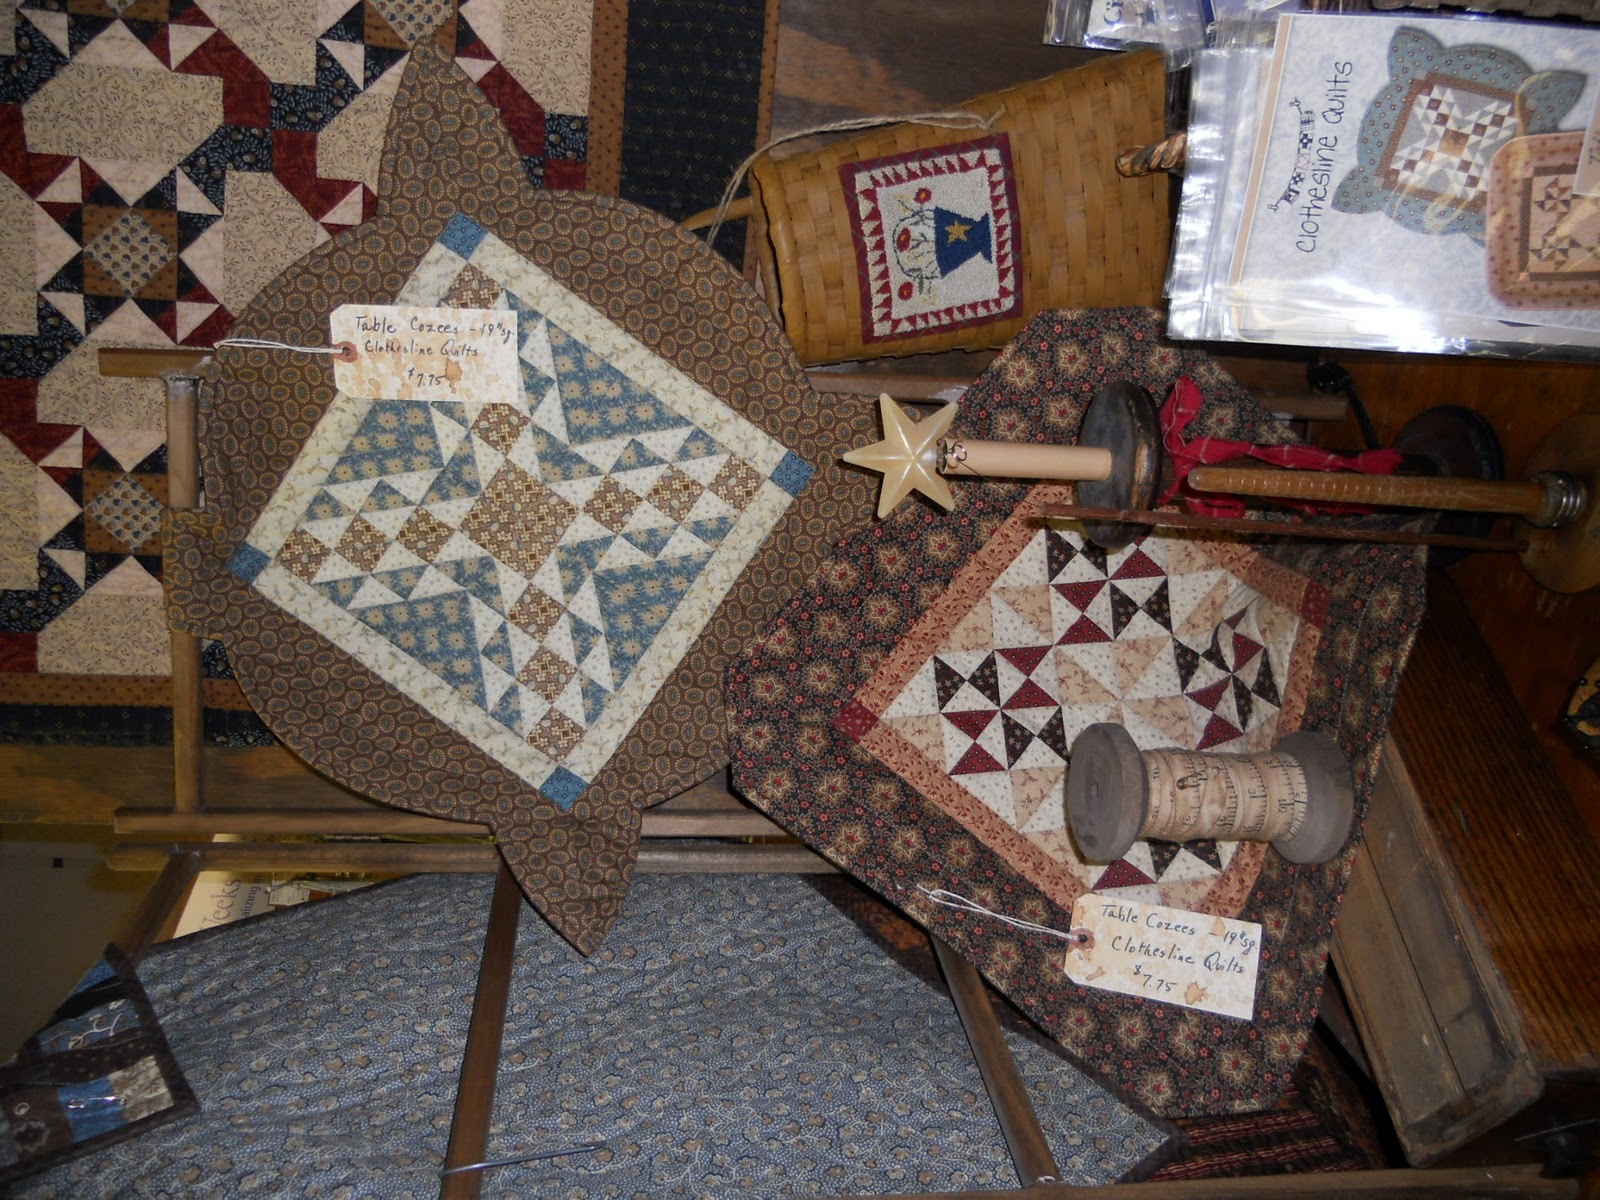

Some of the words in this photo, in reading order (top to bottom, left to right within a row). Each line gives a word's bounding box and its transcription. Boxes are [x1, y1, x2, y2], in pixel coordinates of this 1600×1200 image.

[1296, 135, 1338, 253] Clothesline
[1321, 61, 1353, 125] Quilts
[356, 316, 397, 334] Table
[410, 316, 459, 335] Cozees
[364, 338, 434, 357] Clothesline
[440, 338, 479, 357] Quilts
[240, 887, 262, 918] alizing
[1101, 904, 1138, 923] Table
[1145, 912, 1196, 936] Cozees
[1111, 935, 1195, 964] Clothesline
[1203, 951, 1244, 974] Quilts
